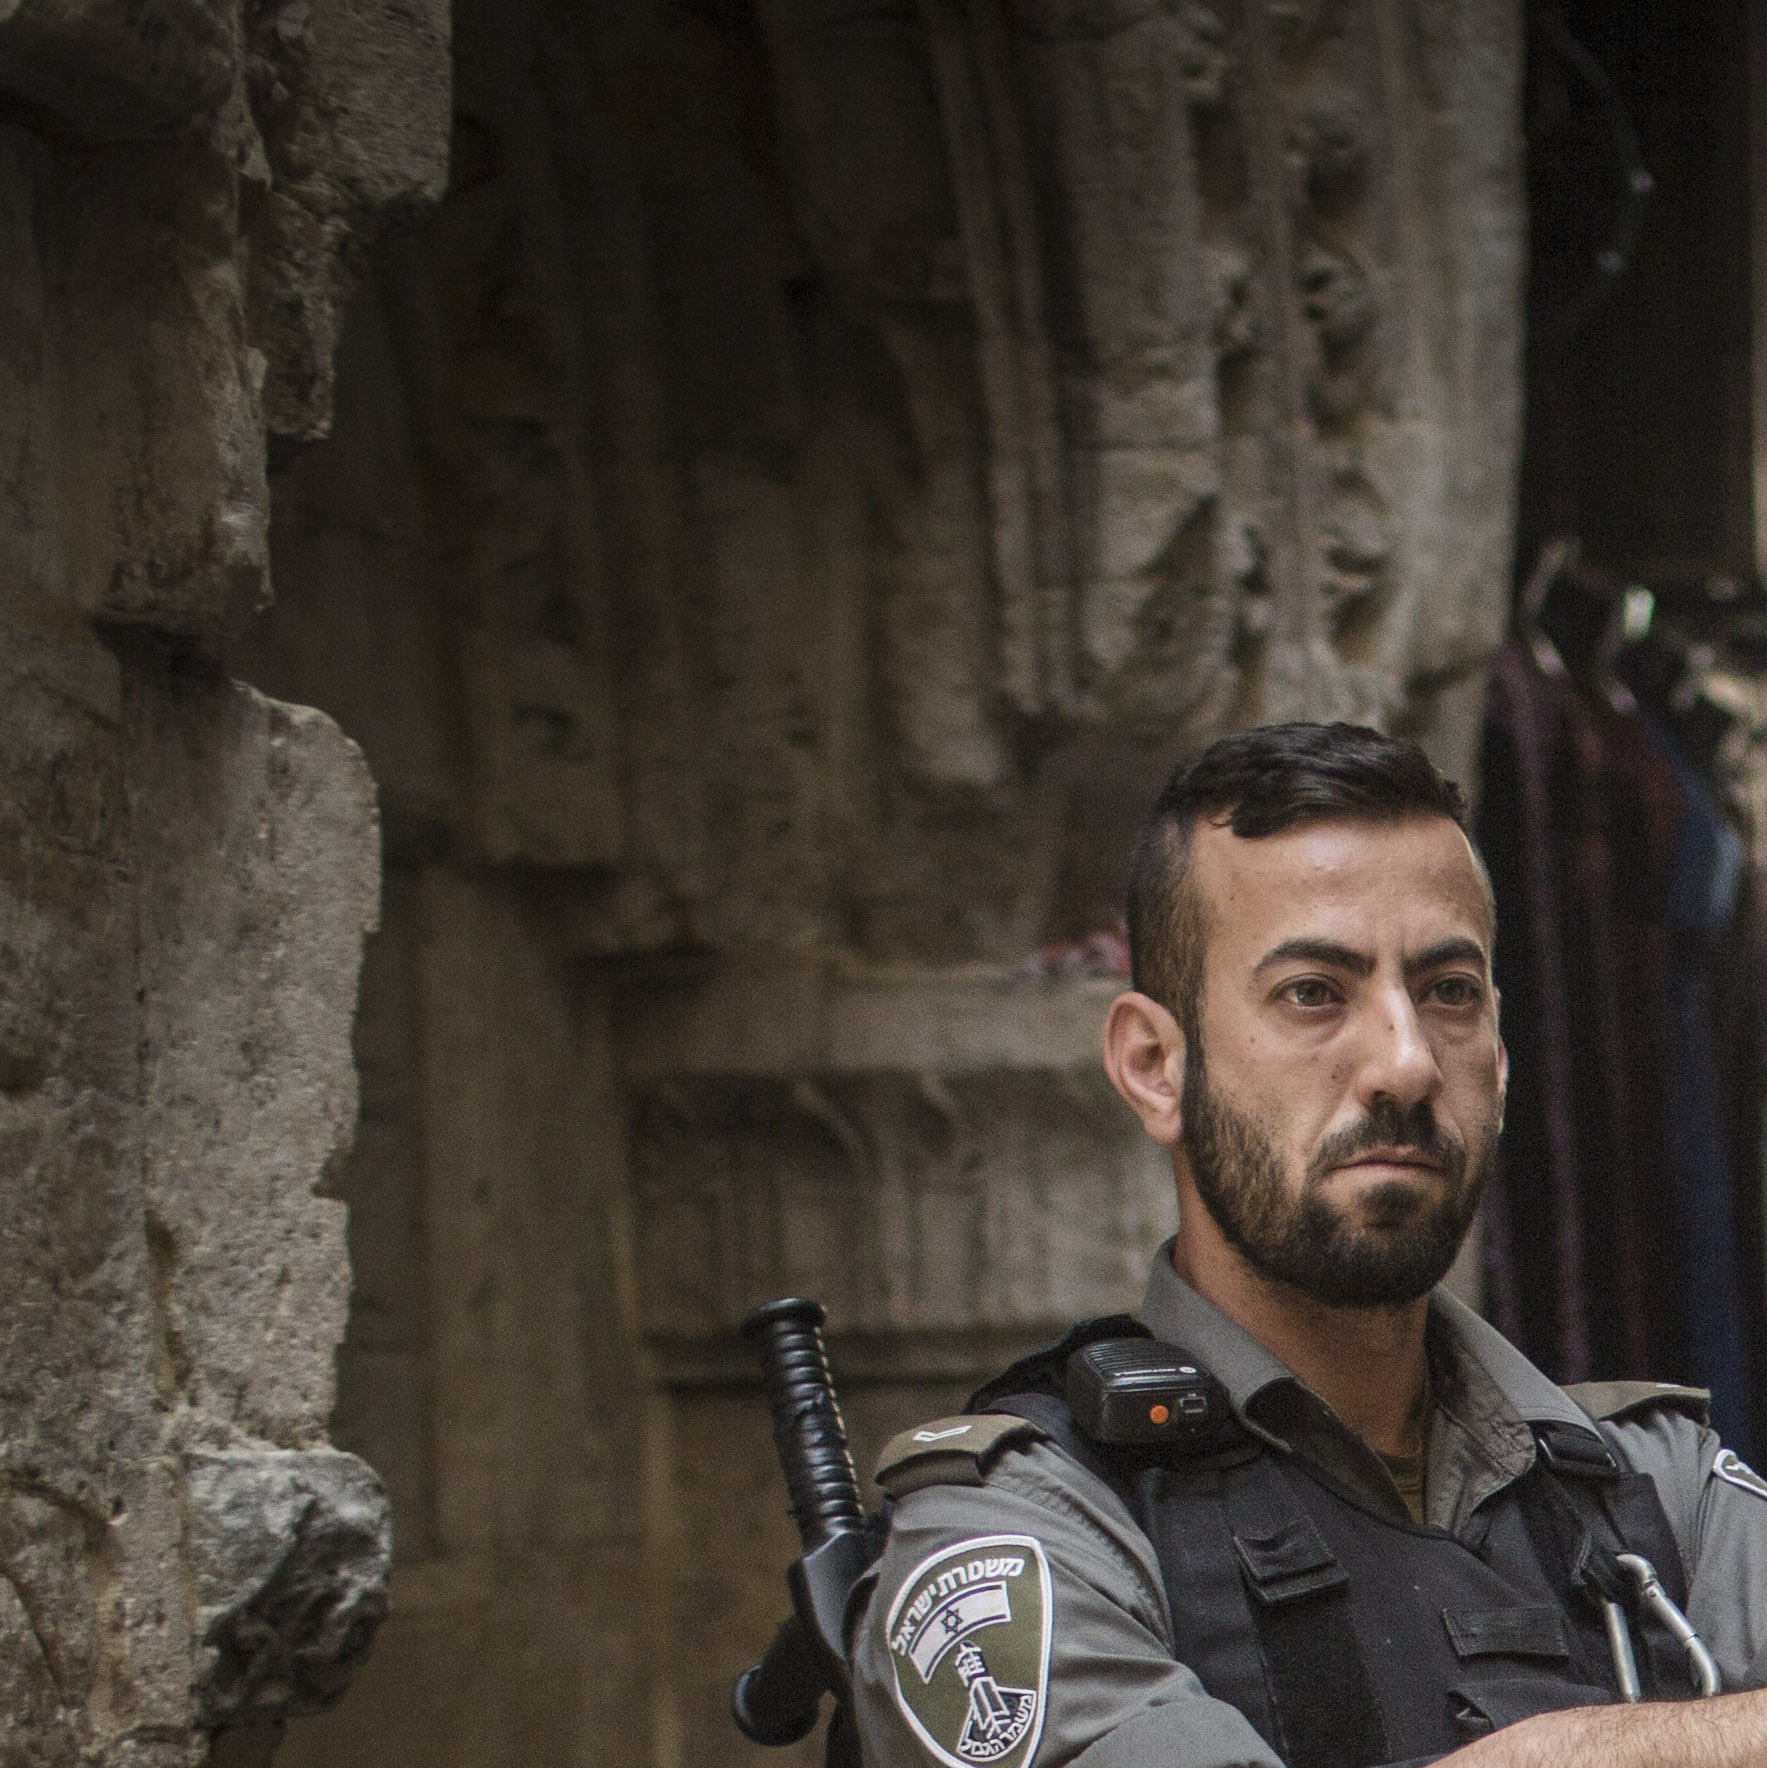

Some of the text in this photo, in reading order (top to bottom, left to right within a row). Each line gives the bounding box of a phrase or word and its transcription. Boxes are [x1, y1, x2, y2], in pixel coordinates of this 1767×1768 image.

[891, 1557, 1025, 1656] משטרת ישראל
[960, 1694, 1034, 1757] משמר הגבול
